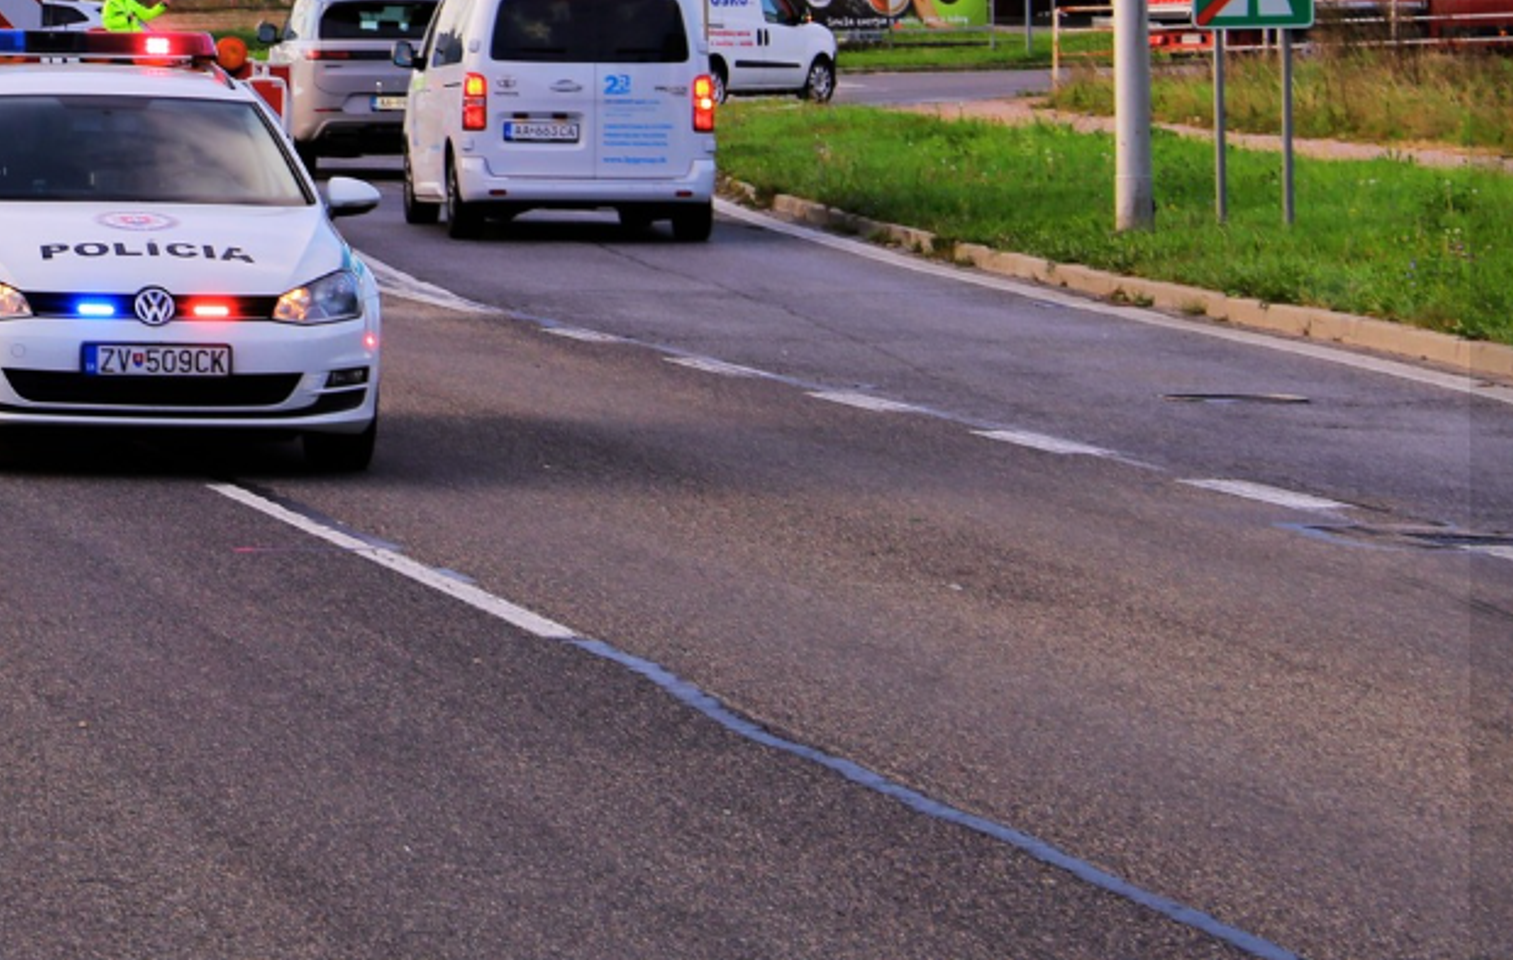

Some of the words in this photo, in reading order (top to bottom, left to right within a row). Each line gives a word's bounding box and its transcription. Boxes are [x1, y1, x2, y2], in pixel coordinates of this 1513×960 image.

[40, 238, 255, 263] POLÍCIA
[100, 348, 131, 373] ZV
[146, 349, 226, 373] 509CK
